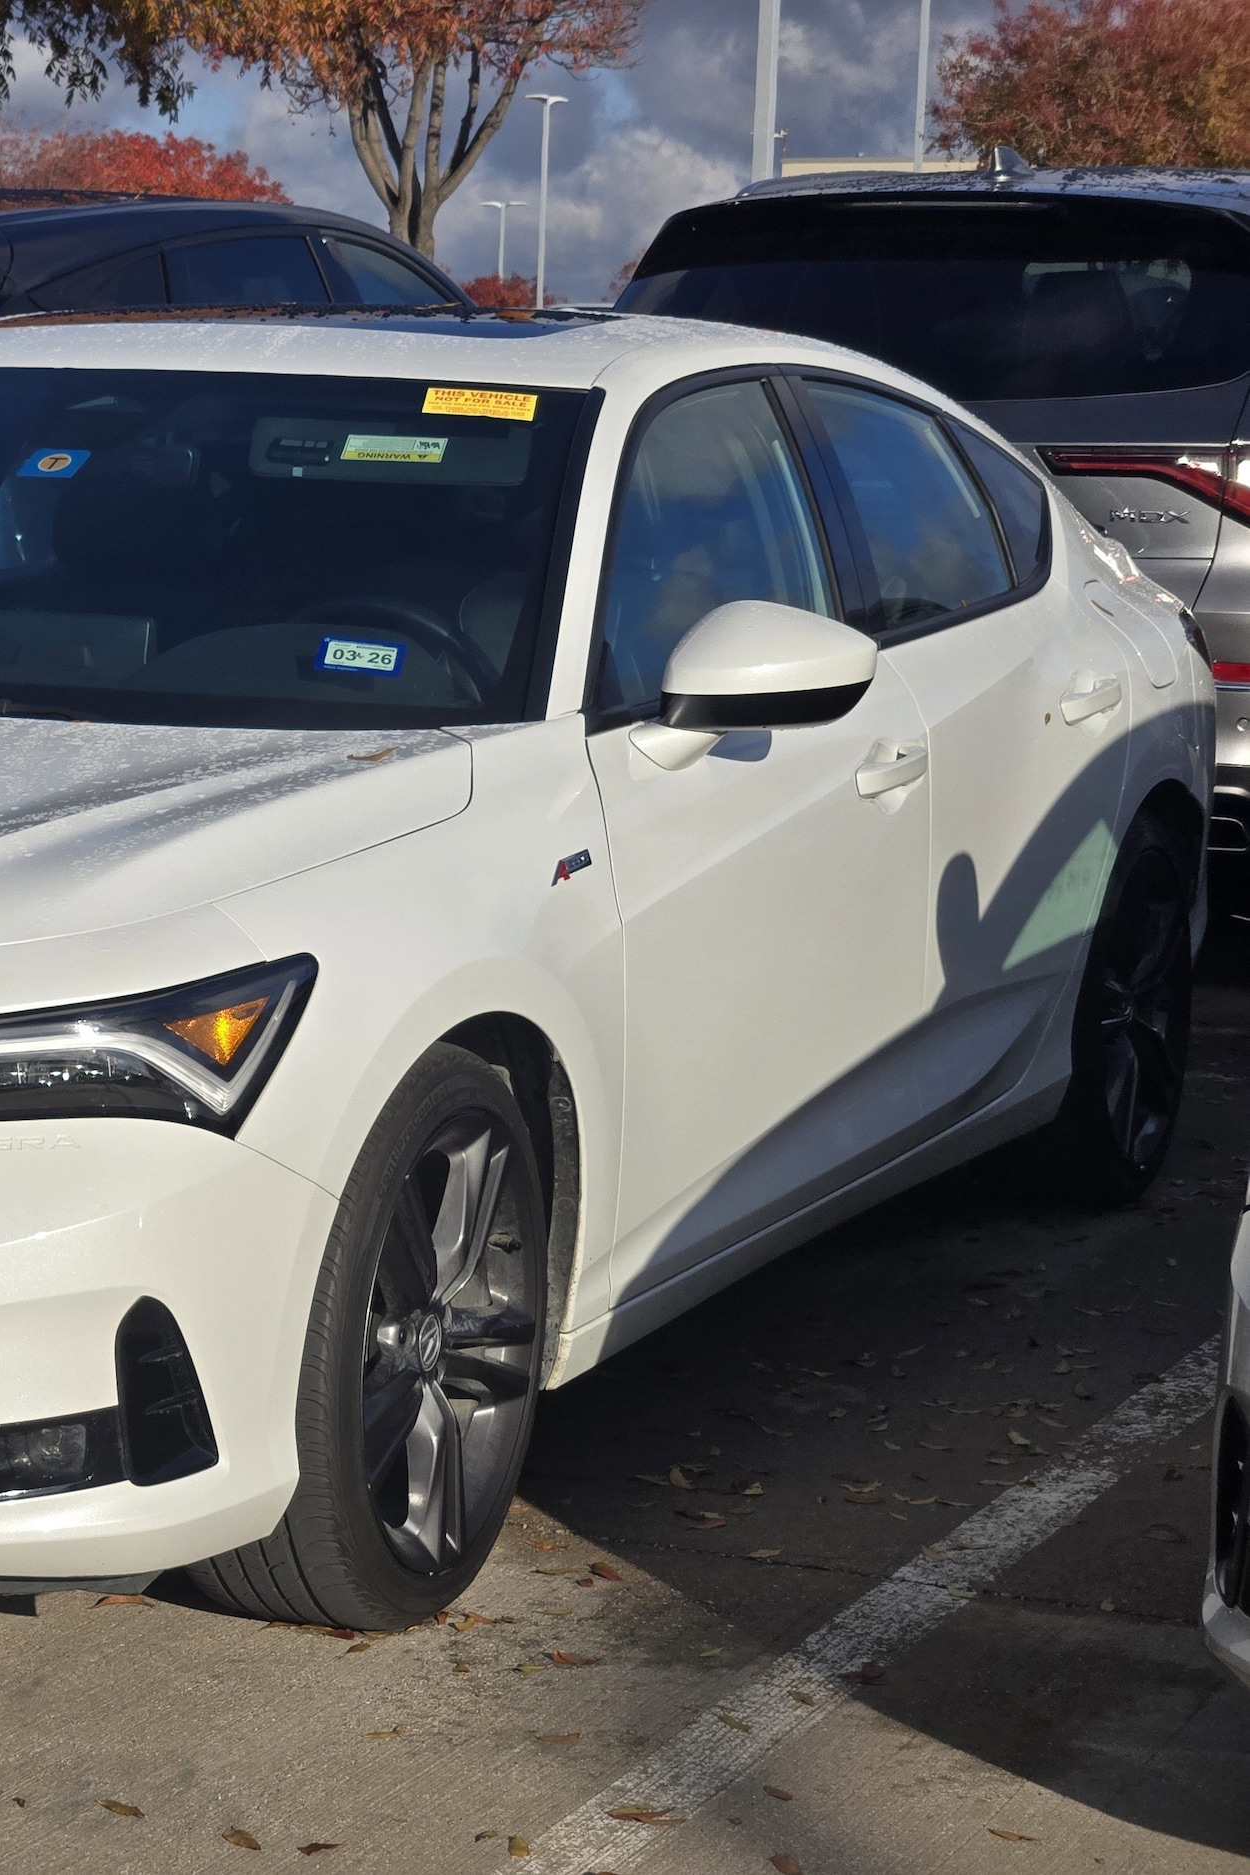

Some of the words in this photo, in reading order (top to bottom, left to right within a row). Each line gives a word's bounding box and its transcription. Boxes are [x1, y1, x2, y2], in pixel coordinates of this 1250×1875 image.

[470, 392, 532, 402] VEHICLE
[356, 452, 411, 460] WARNING
[47, 457, 68, 470] T
[1109, 507, 1191, 524] MDX
[332, 649, 357, 661] 03
[367, 652, 393, 665] 26
